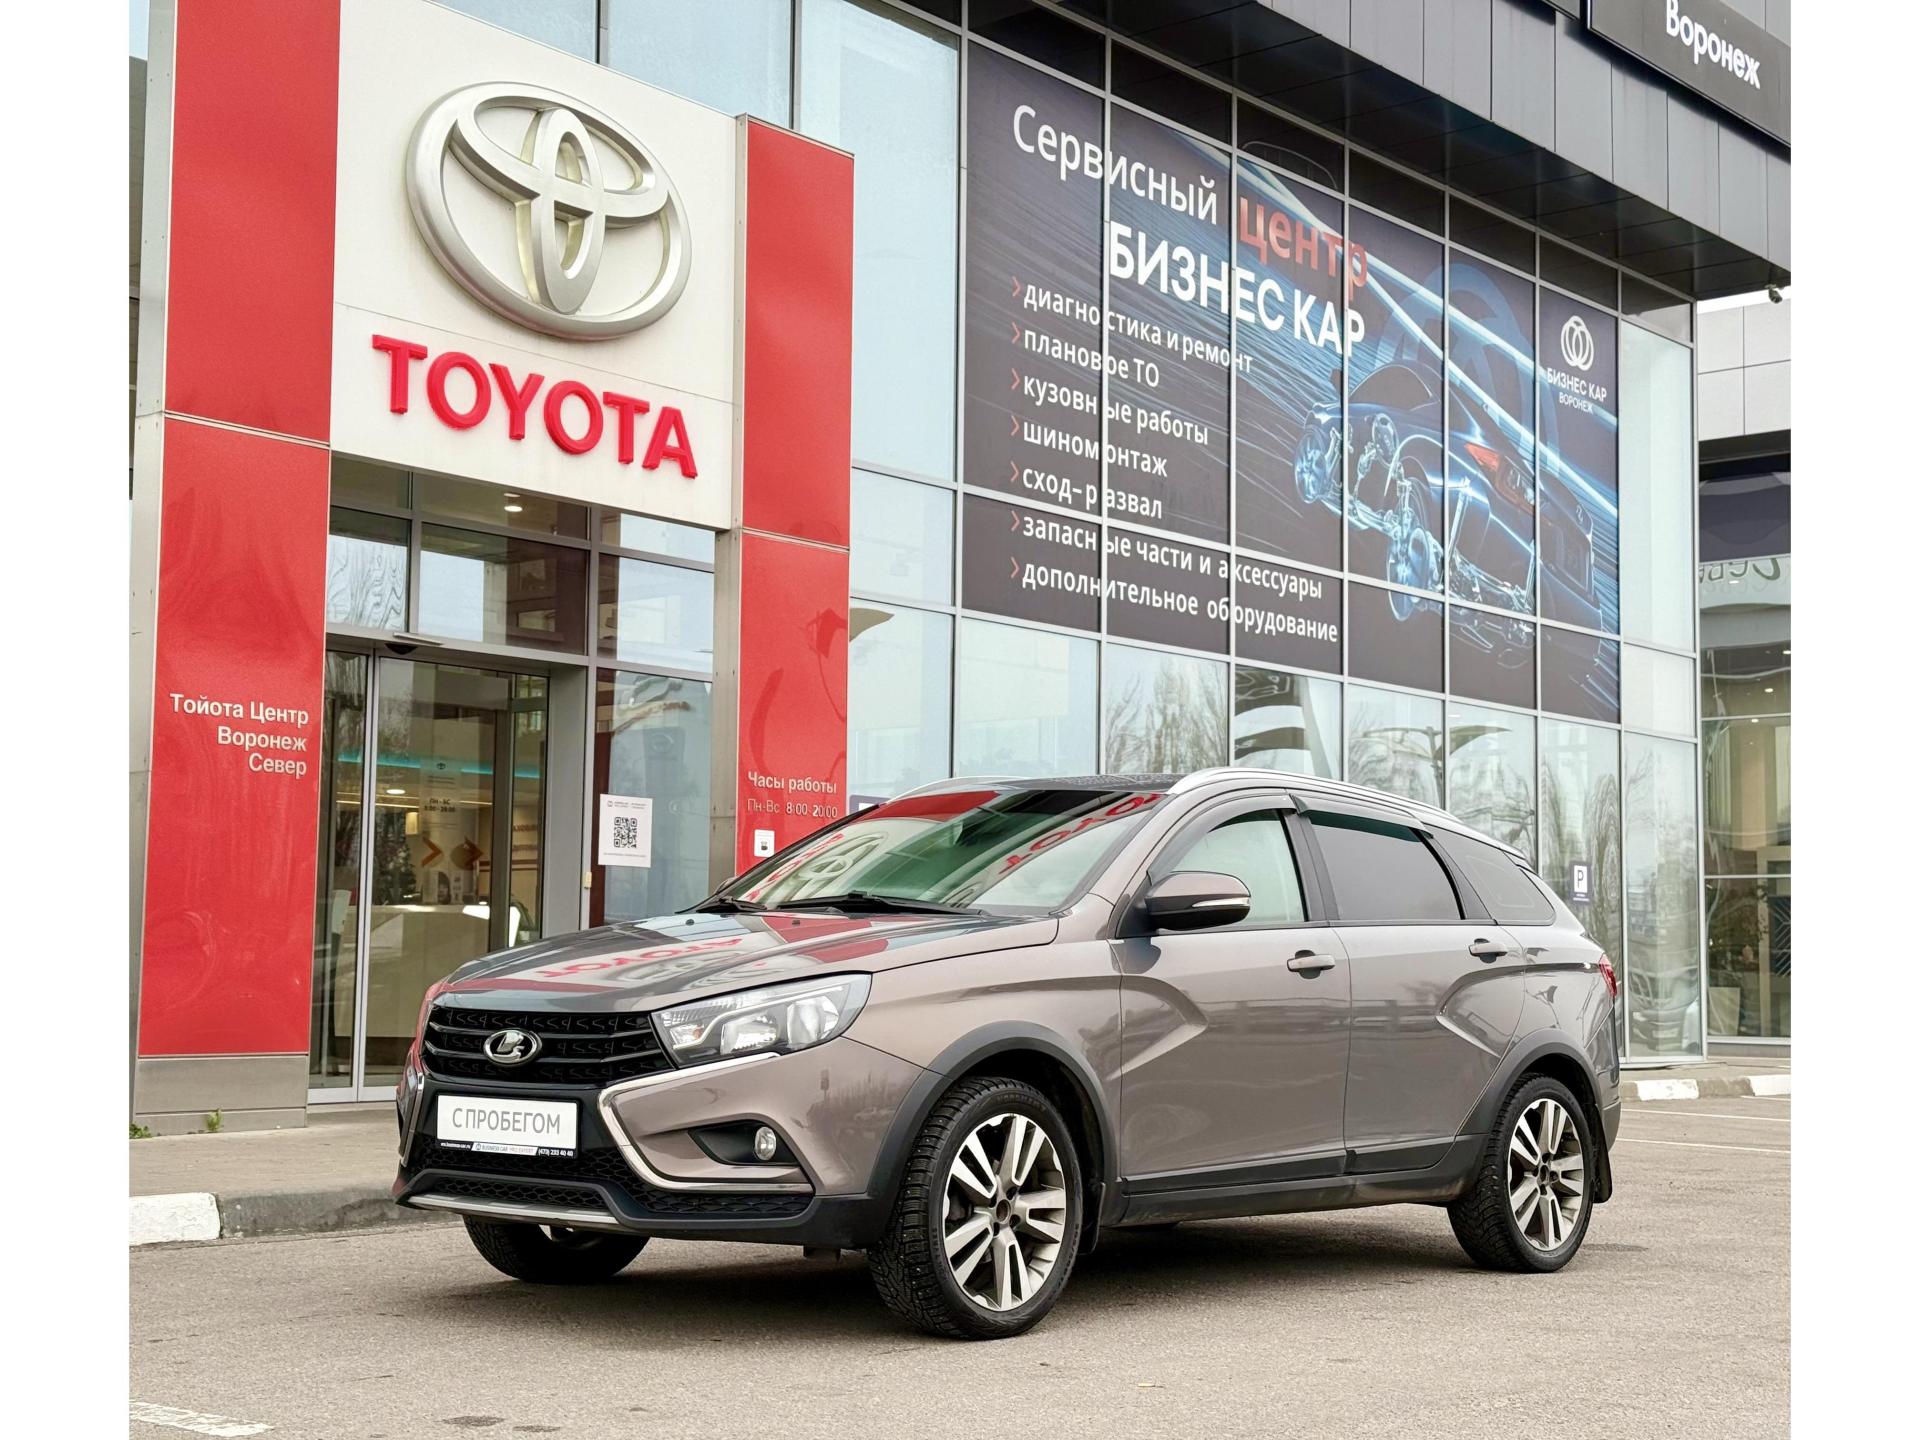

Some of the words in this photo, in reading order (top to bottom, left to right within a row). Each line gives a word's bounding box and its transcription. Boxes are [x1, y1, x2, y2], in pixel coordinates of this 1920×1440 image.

[1666, 0, 1760, 89] Воронеж
[1013, 104, 1217, 225] Сервисный
[1239, 196, 1368, 301] центр
[1109, 220, 1285, 331] БИЗНЕС
[1293, 288, 1365, 357] КАР
[1023, 284, 1161, 346] диагностика
[1167, 330, 1179, 351] и
[1183, 335, 1253, 373] ремонт
[1024, 330, 1129, 379] плановое
[1133, 358, 1159, 388] ТО
[1547, 367, 1587, 396] БИЗНЕС
[1588, 382, 1607, 402] КАР
[371, 334, 698, 479] TOYOTA
[1023, 375, 1132, 424] кузовные
[1137, 409, 1208, 445] работы
[1559, 391, 1594, 415] ВОРОНЕЖ
[1023, 421, 1168, 478] шиномонтаж
[1023, 516, 1131, 557] запасные
[1136, 541, 1192, 571] части
[1199, 554, 1211, 576] и
[1218, 558, 1321, 601] аксессуары
[1022, 563, 1198, 615] дополнительное
[1207, 597, 1338, 642] оборудование
[170, 693, 244, 718] Тойота
[250, 701, 309, 728] Центр
[217, 725, 307, 752] Воронеж
[248, 752, 307, 780] Север
[748, 770, 784, 789] Часы
[788, 776, 837, 794] работы
[452, 1108, 463, 1128] С
[465, 1108, 561, 1135] ПРОБЕГОМ
